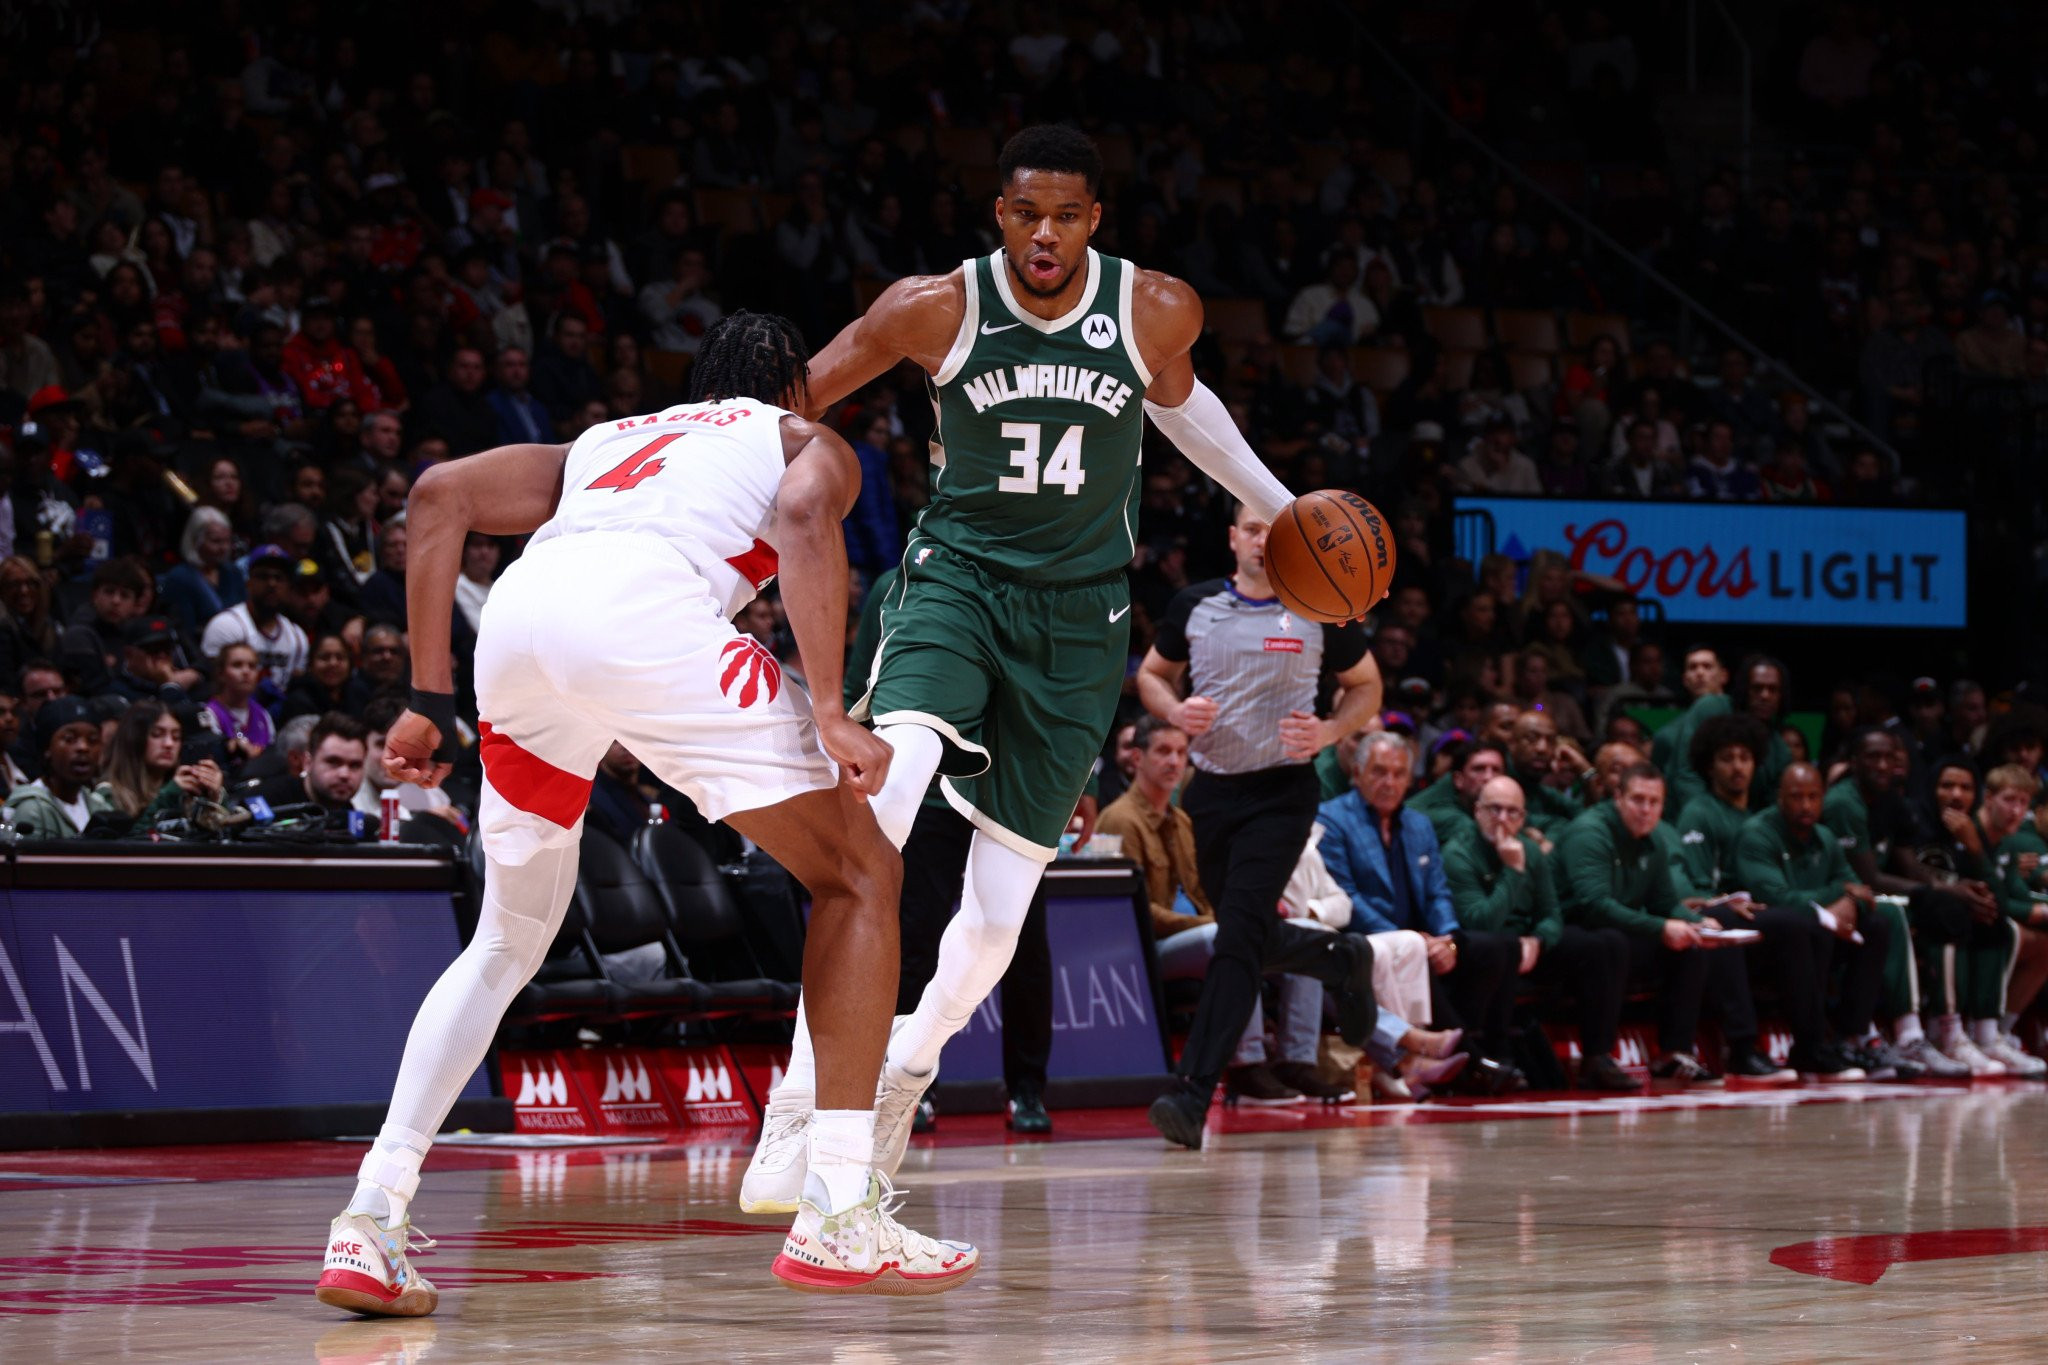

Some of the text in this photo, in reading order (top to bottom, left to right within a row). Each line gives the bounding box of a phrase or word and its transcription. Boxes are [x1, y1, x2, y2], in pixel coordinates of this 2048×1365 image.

[616, 407, 751, 431] BARNES
[962, 364, 1133, 418] MILWAUKEE
[584, 432, 687, 493] 4
[998, 422, 1086, 495] 34
[1564, 519, 1939, 601] Coors LIGHT
[785, 1243, 825, 1266] COUTURE
